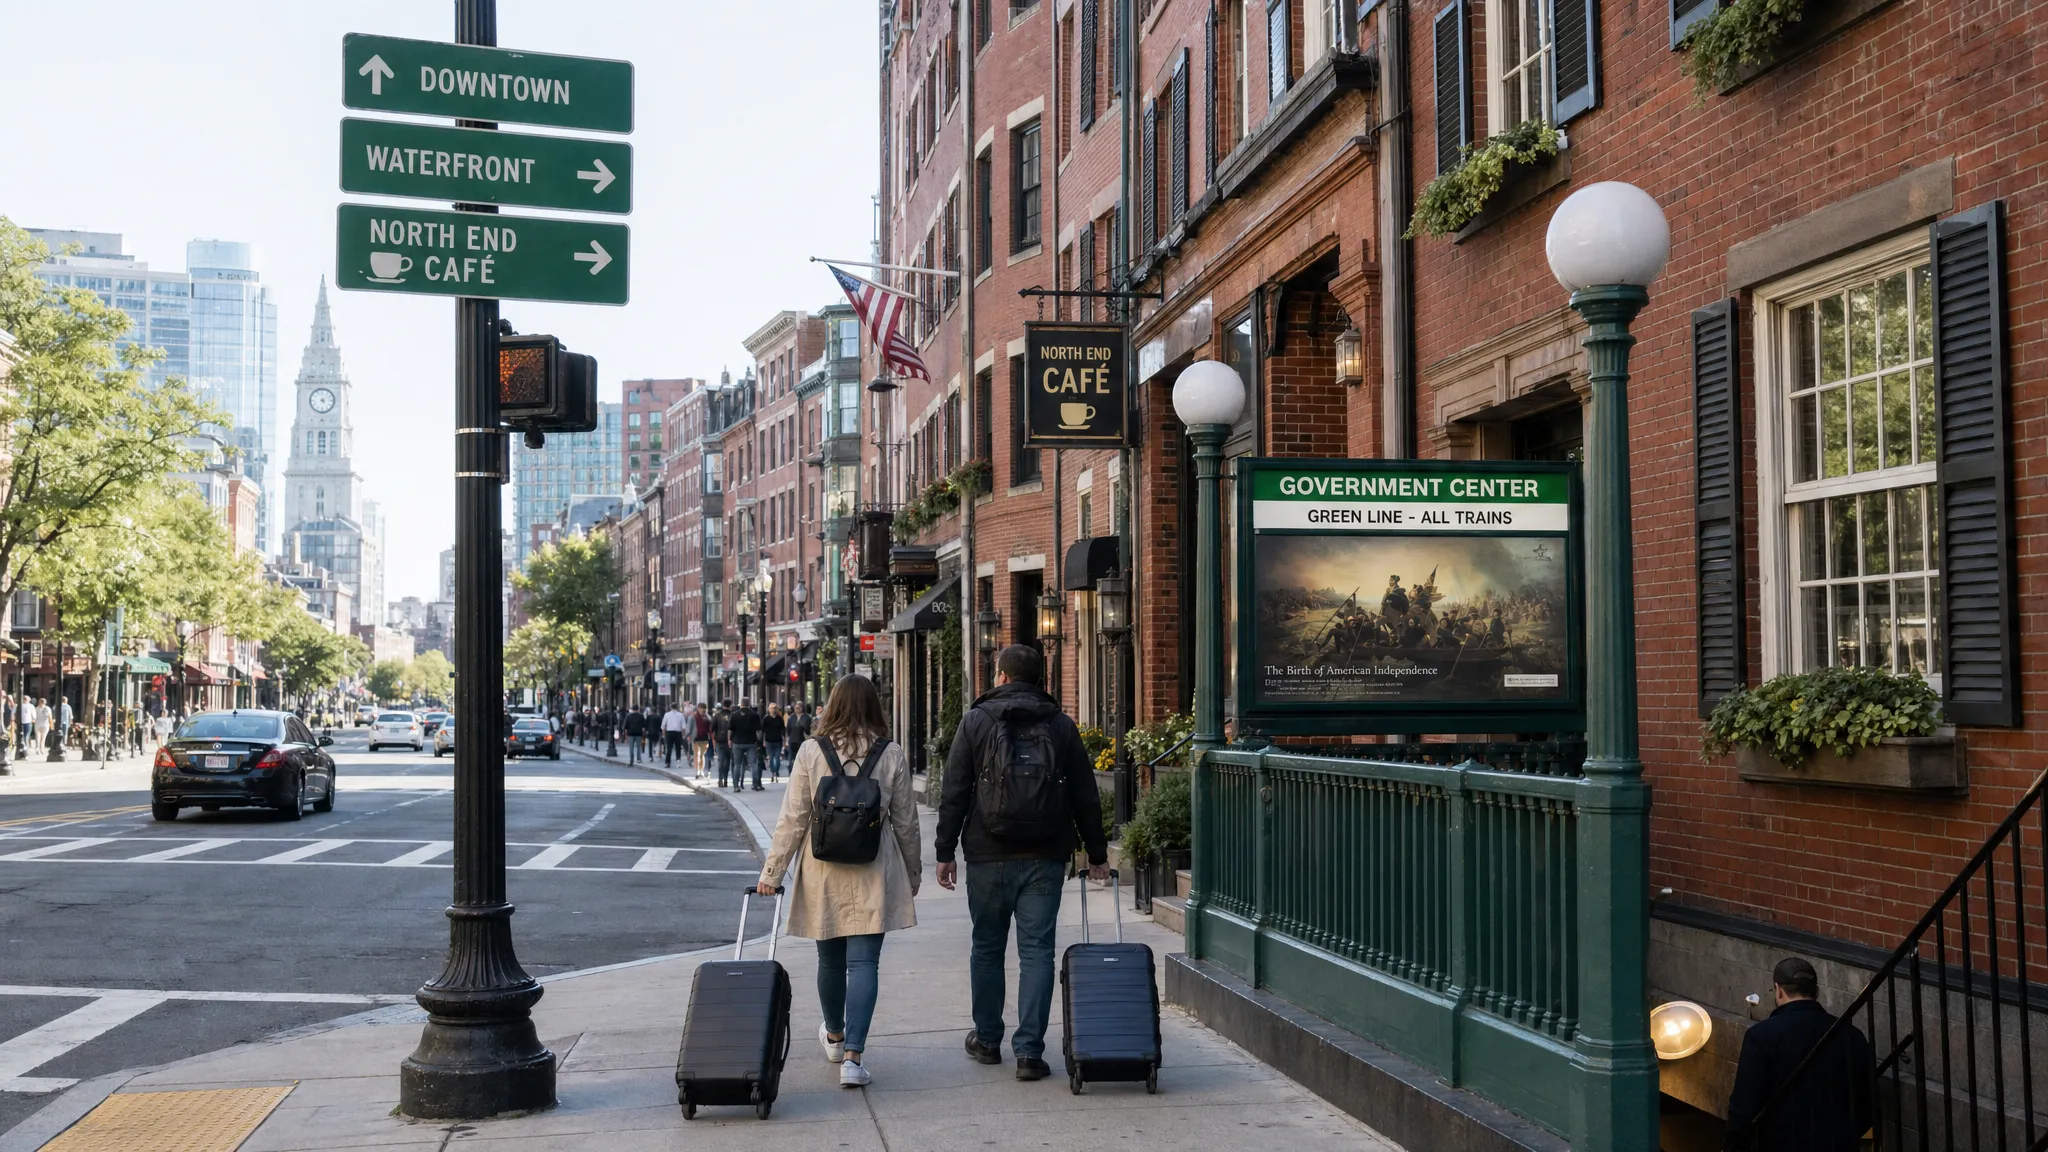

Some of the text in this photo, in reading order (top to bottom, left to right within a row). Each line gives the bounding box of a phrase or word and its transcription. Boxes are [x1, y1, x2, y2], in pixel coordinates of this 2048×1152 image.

[420, 65, 570, 105] DOWNTOWN
[366, 144, 535, 184] WATERFRONT
[370, 218, 517, 253] NORTH END
[424, 254, 495, 284] CAFÉ
[1040, 346, 1111, 361] NORTH END
[1043, 363, 1110, 394] CAFÉ
[1279, 476, 1539, 498] GOVERNMENT CENTER
[1307, 509, 1362, 524] GREEN
[1367, 510, 1403, 524] LINE
[1420, 510, 1450, 525] ALL
[1455, 511, 1513, 525] TRAINS
[1264, 665, 1438, 678] The Birth of American Independence
